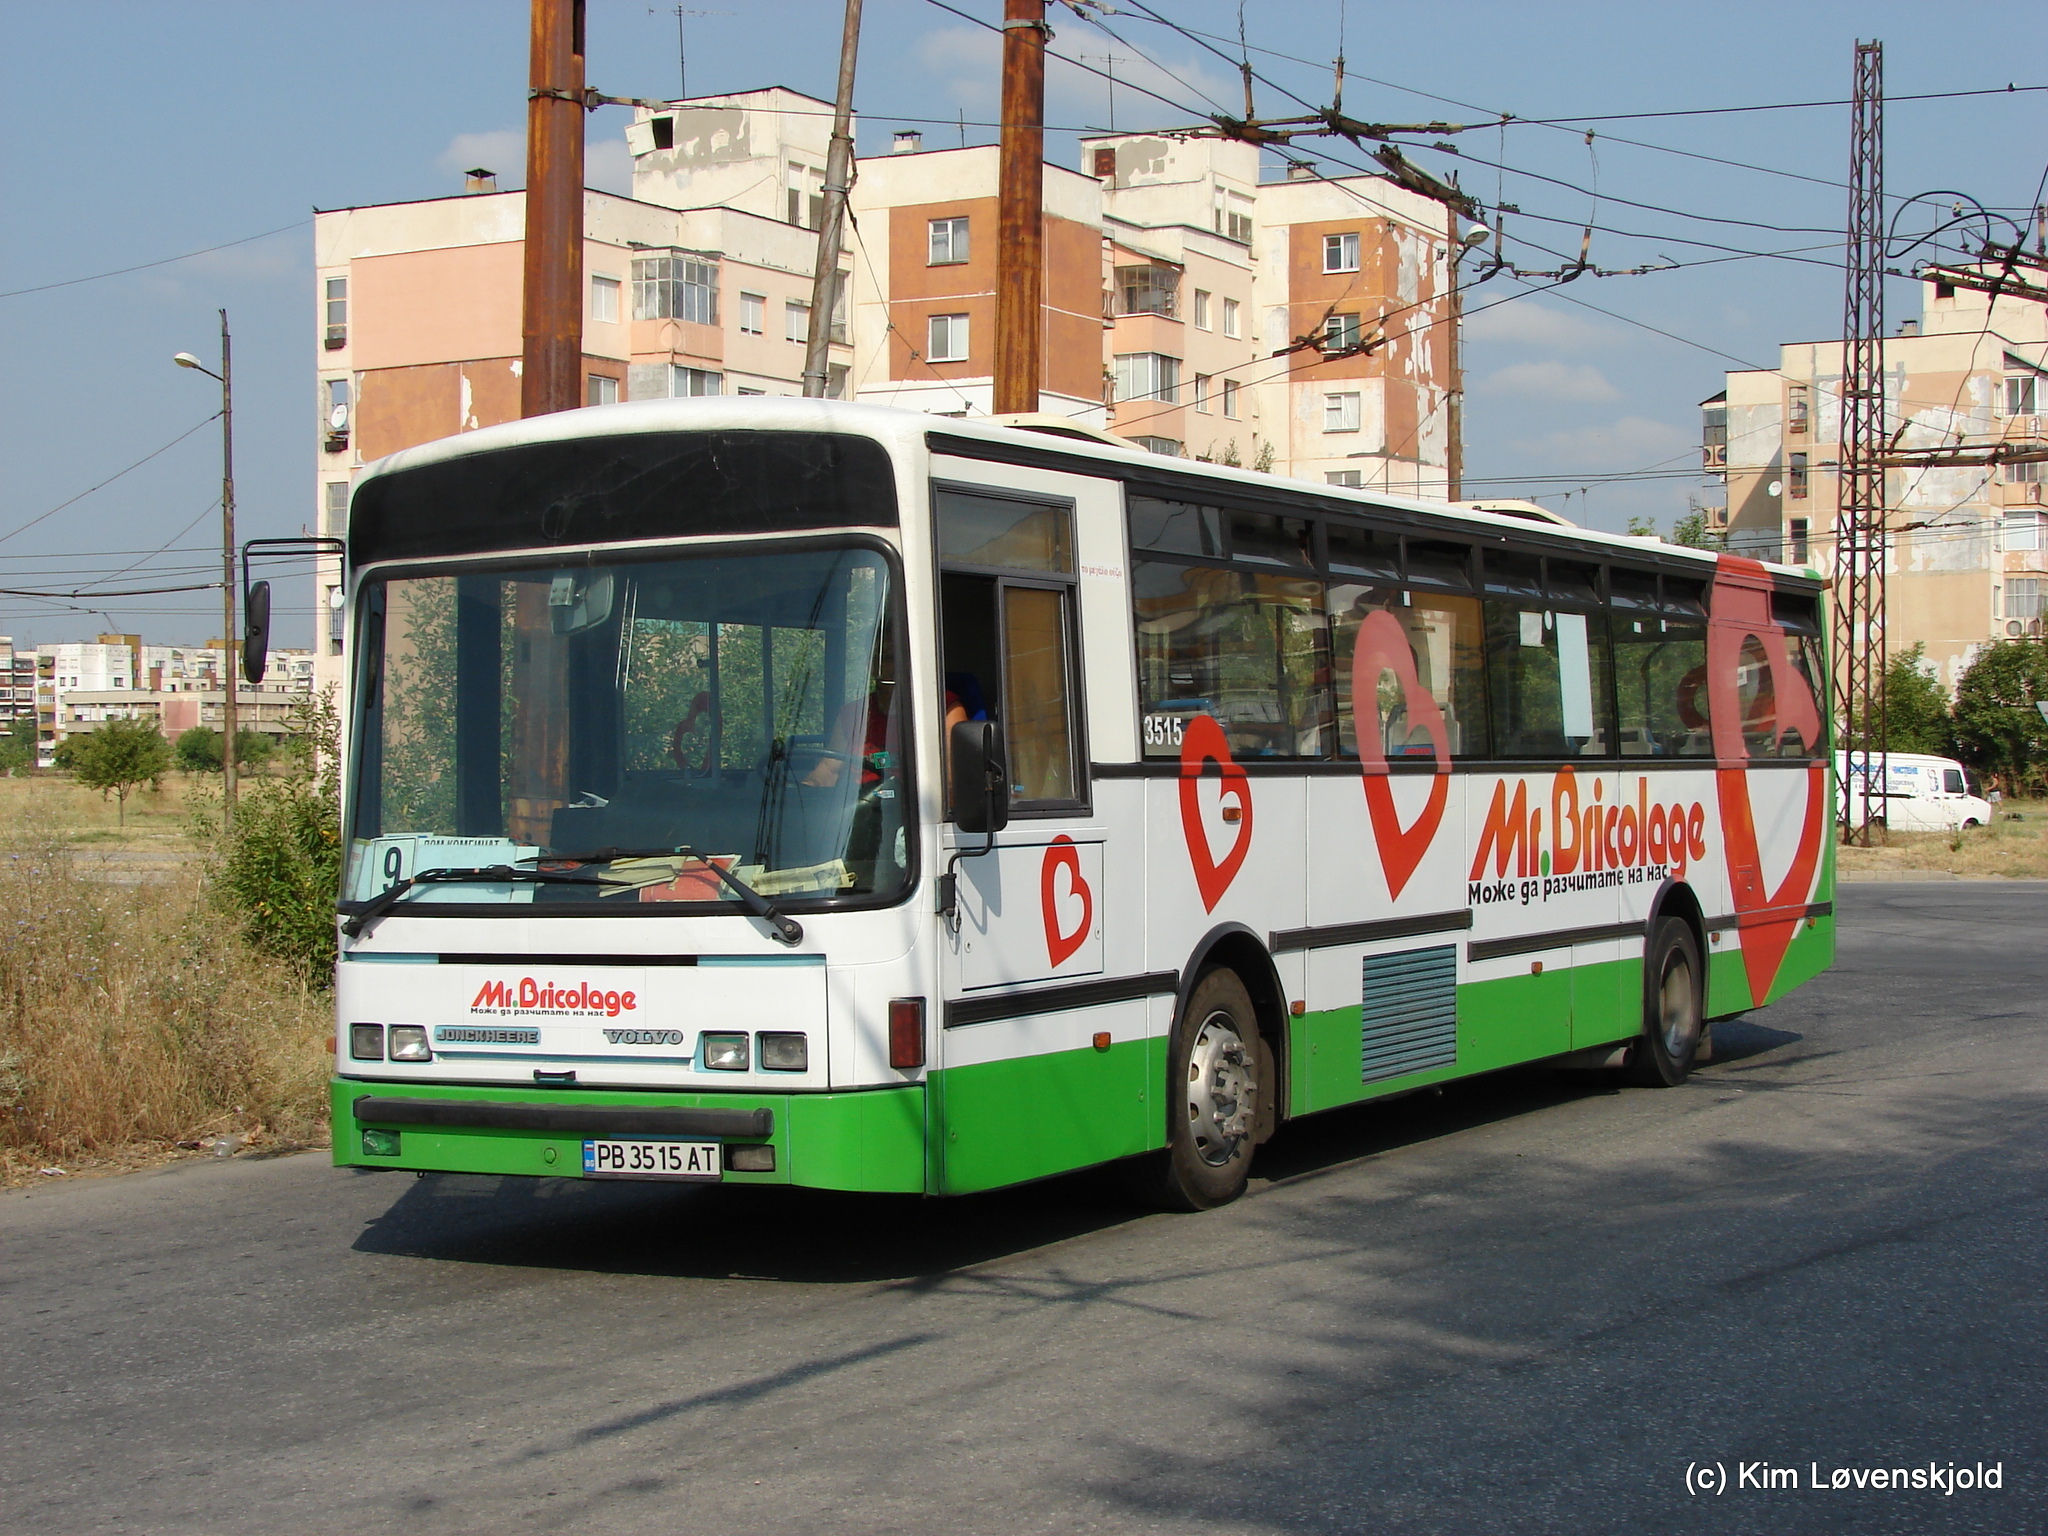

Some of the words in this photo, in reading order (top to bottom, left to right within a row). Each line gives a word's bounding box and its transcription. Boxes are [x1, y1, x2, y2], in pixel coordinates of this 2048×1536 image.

[1144, 716, 1182, 746] 3515
[383, 846, 403, 892] 9
[1469, 880, 1516, 905] Може
[1520, 880, 1539, 906] да
[1543, 869, 1624, 902] разчитате
[1628, 867, 1643, 884] на
[1647, 864, 1667, 881] нас
[470, 1007, 498, 1015] Може
[500, 1009, 512, 1017] да
[514, 1009, 570, 1017] разчитате
[471, 977, 637, 1018] Mr.Bricolage
[436, 1028, 539, 1044] JONCKHEERE
[603, 1029, 684, 1045] VOLVO
[598, 1144, 625, 1169] PB
[630, 1145, 682, 1171] 3515
[688, 1146, 715, 1171] AT
